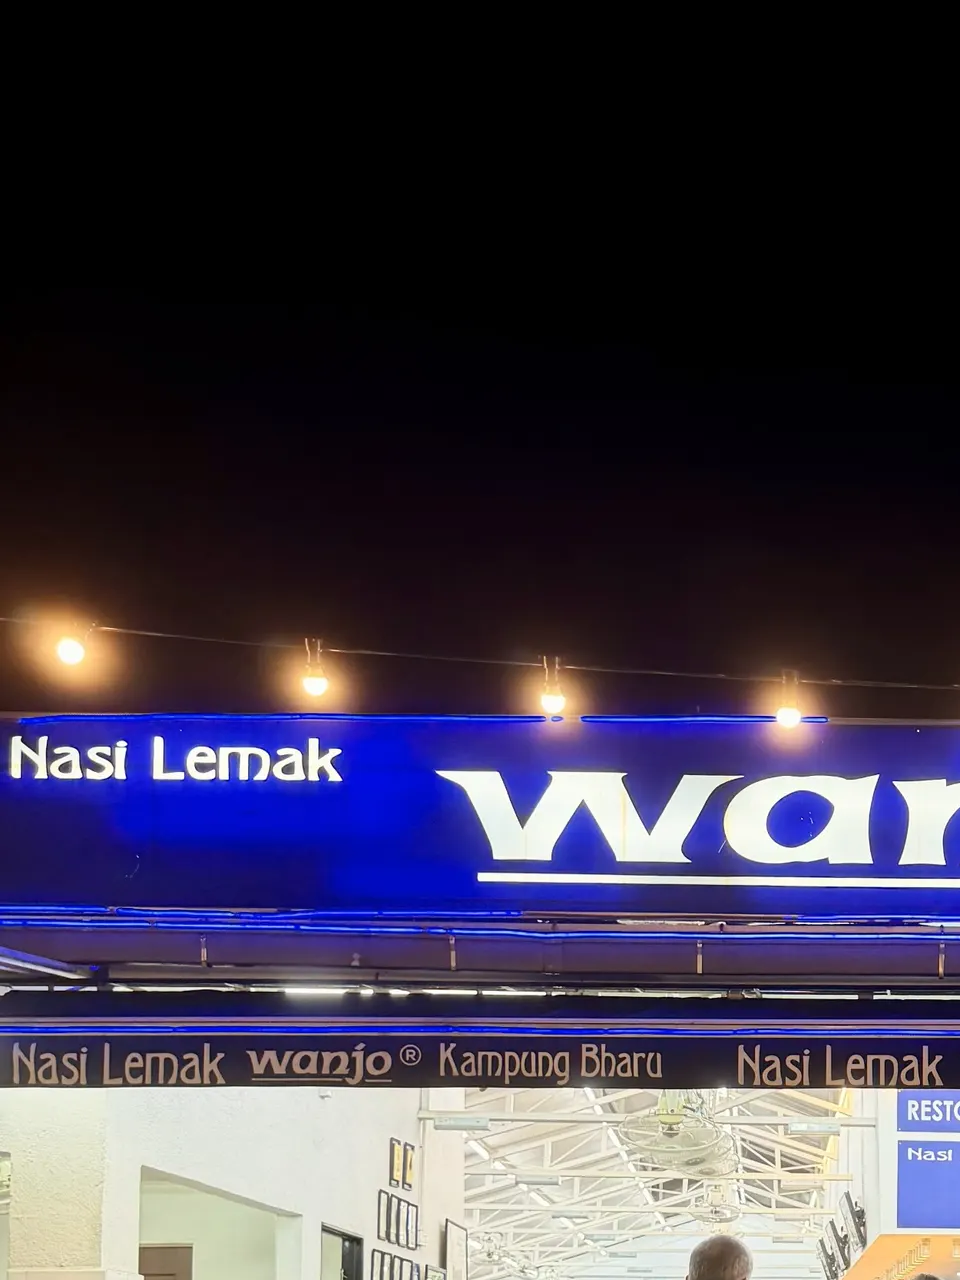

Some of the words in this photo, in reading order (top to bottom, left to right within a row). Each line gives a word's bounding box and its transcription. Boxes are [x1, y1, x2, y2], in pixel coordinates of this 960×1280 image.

[9, 735, 128, 781] Nasi
[152, 735, 343, 782] Lemak
[11, 1042, 88, 1085] Nasi
[102, 1042, 226, 1085] Lemak
[246, 1042, 392, 1085] wanjo
[439, 1042, 570, 1084] Kampung
[580, 1042, 663, 1078] Bharu
[737, 1044, 811, 1086] Nasi
[825, 1044, 944, 1087] Lemak
[907, 1147, 953, 1163] Nasi
